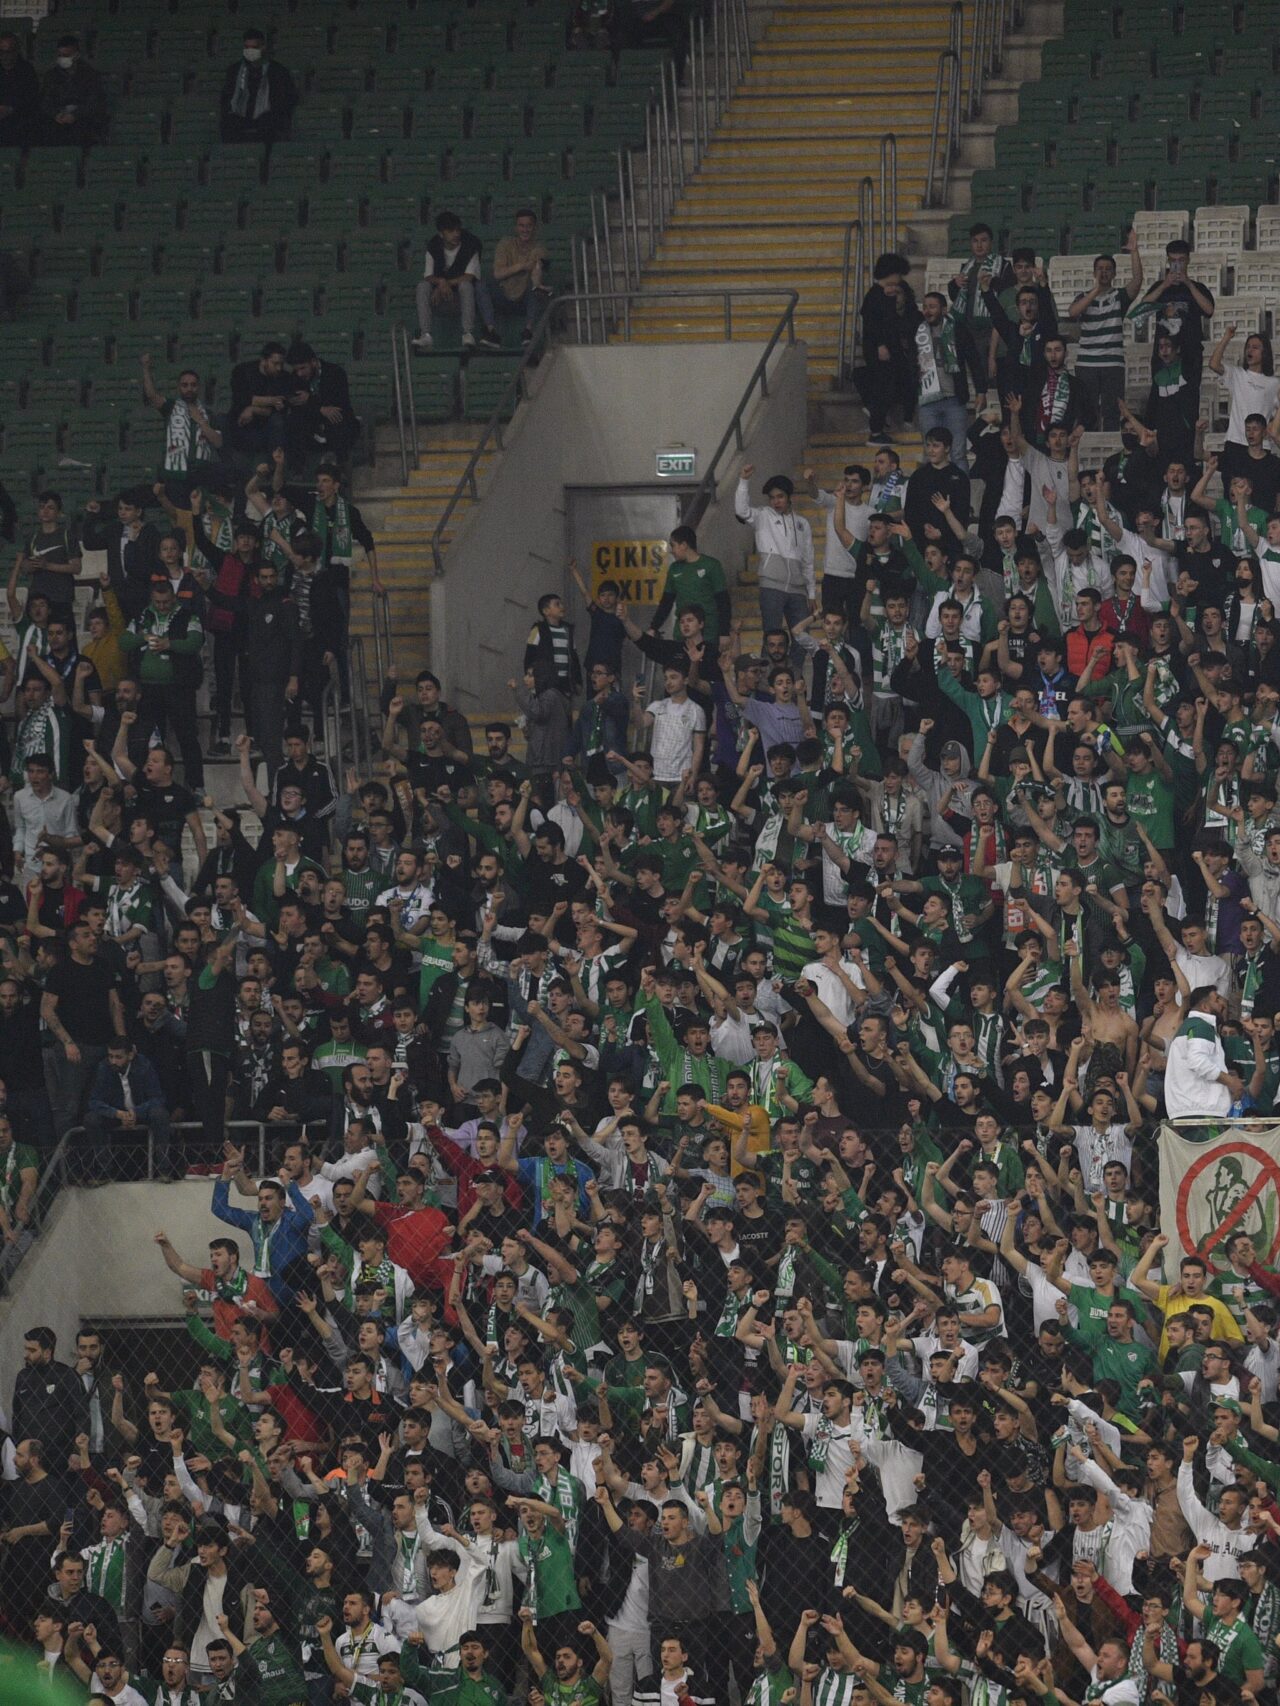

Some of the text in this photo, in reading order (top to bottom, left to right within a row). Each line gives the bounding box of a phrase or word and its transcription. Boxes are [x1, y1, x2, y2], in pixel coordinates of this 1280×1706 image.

[660, 459, 692, 471] EXIT
[597, 546, 663, 575] ÇIKIŞ
[603, 579, 658, 600] XIT
[738, 1231, 769, 1241] LACOSTE
[771, 1427, 785, 1488] SPOR
